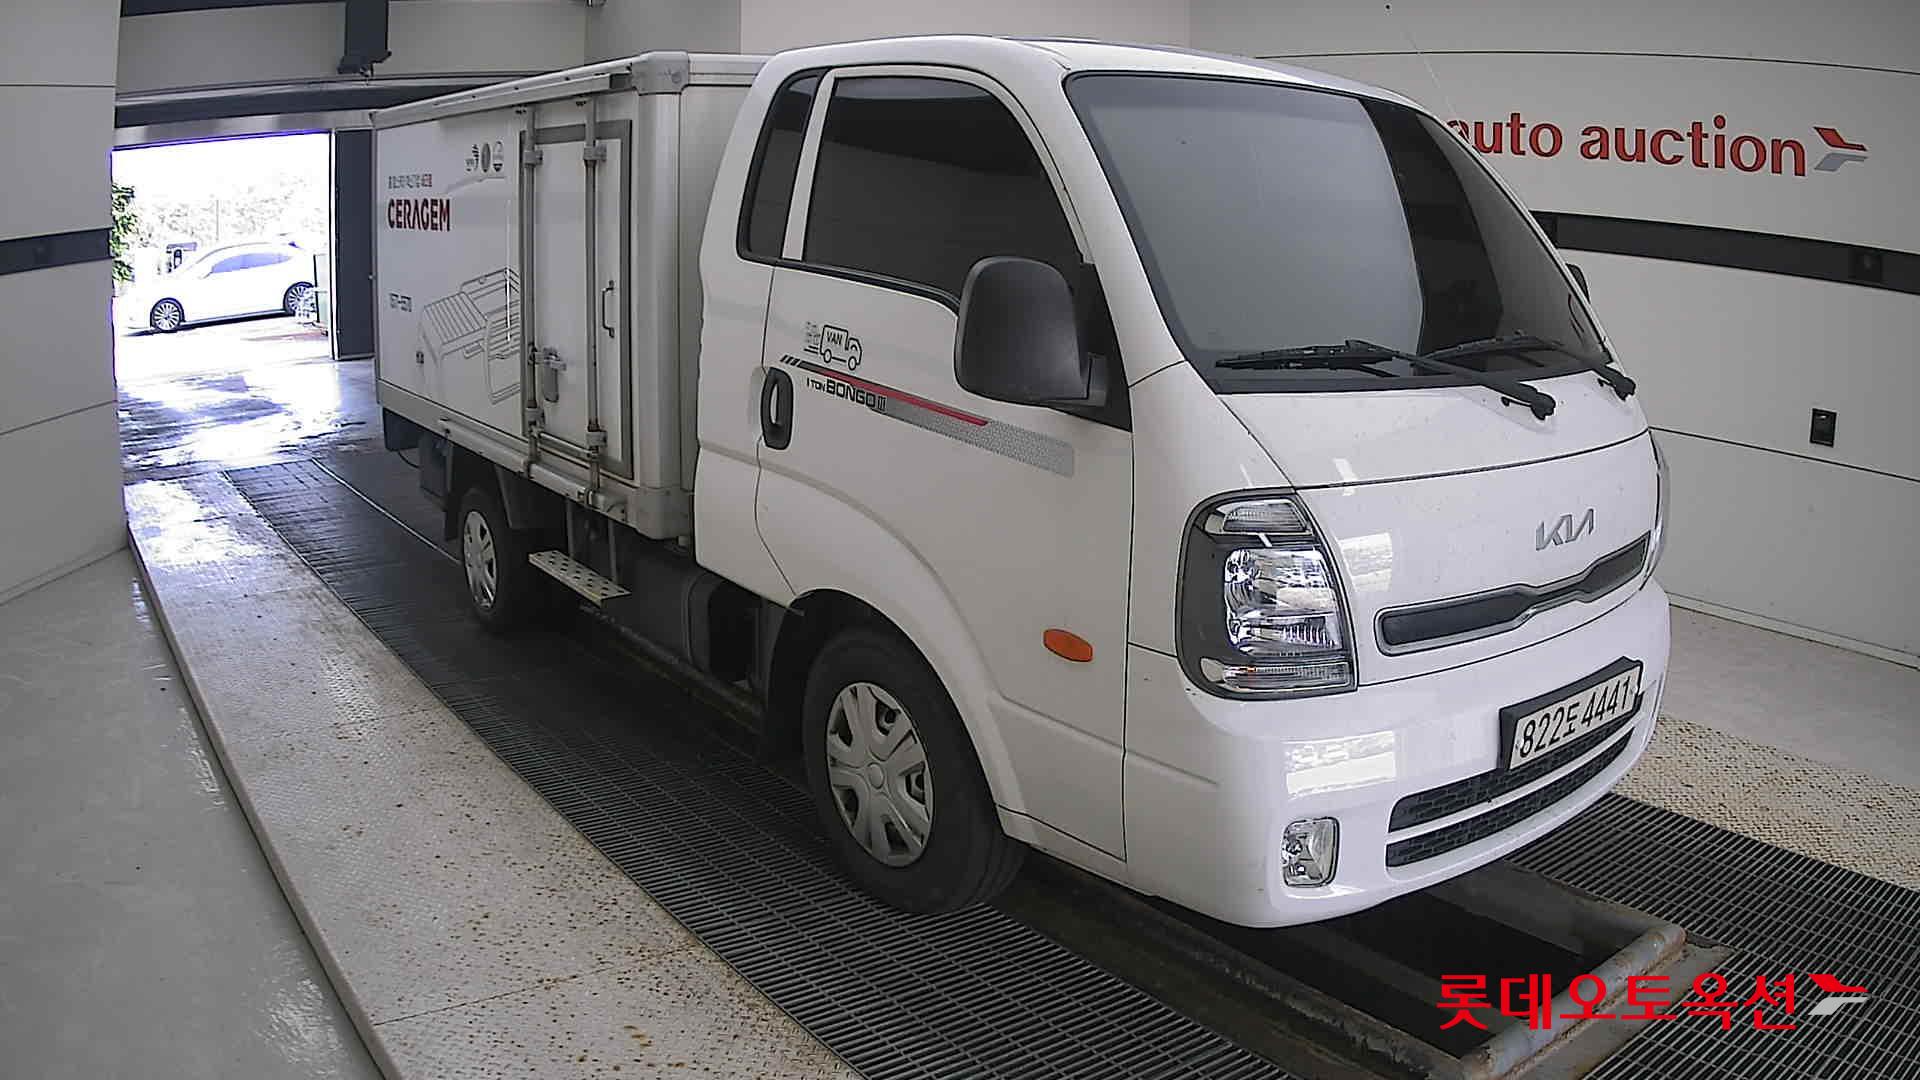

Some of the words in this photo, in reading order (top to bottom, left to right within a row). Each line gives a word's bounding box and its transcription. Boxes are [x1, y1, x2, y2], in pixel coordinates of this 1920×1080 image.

[1579, 114, 1806, 177] auction
[387, 198, 451, 232] CERAGEM
[826, 330, 843, 345] VAN
[826, 379, 876, 408] BONGO
[1536, 508, 1594, 551] KIA
[1581, 675, 1632, 728] 4441
